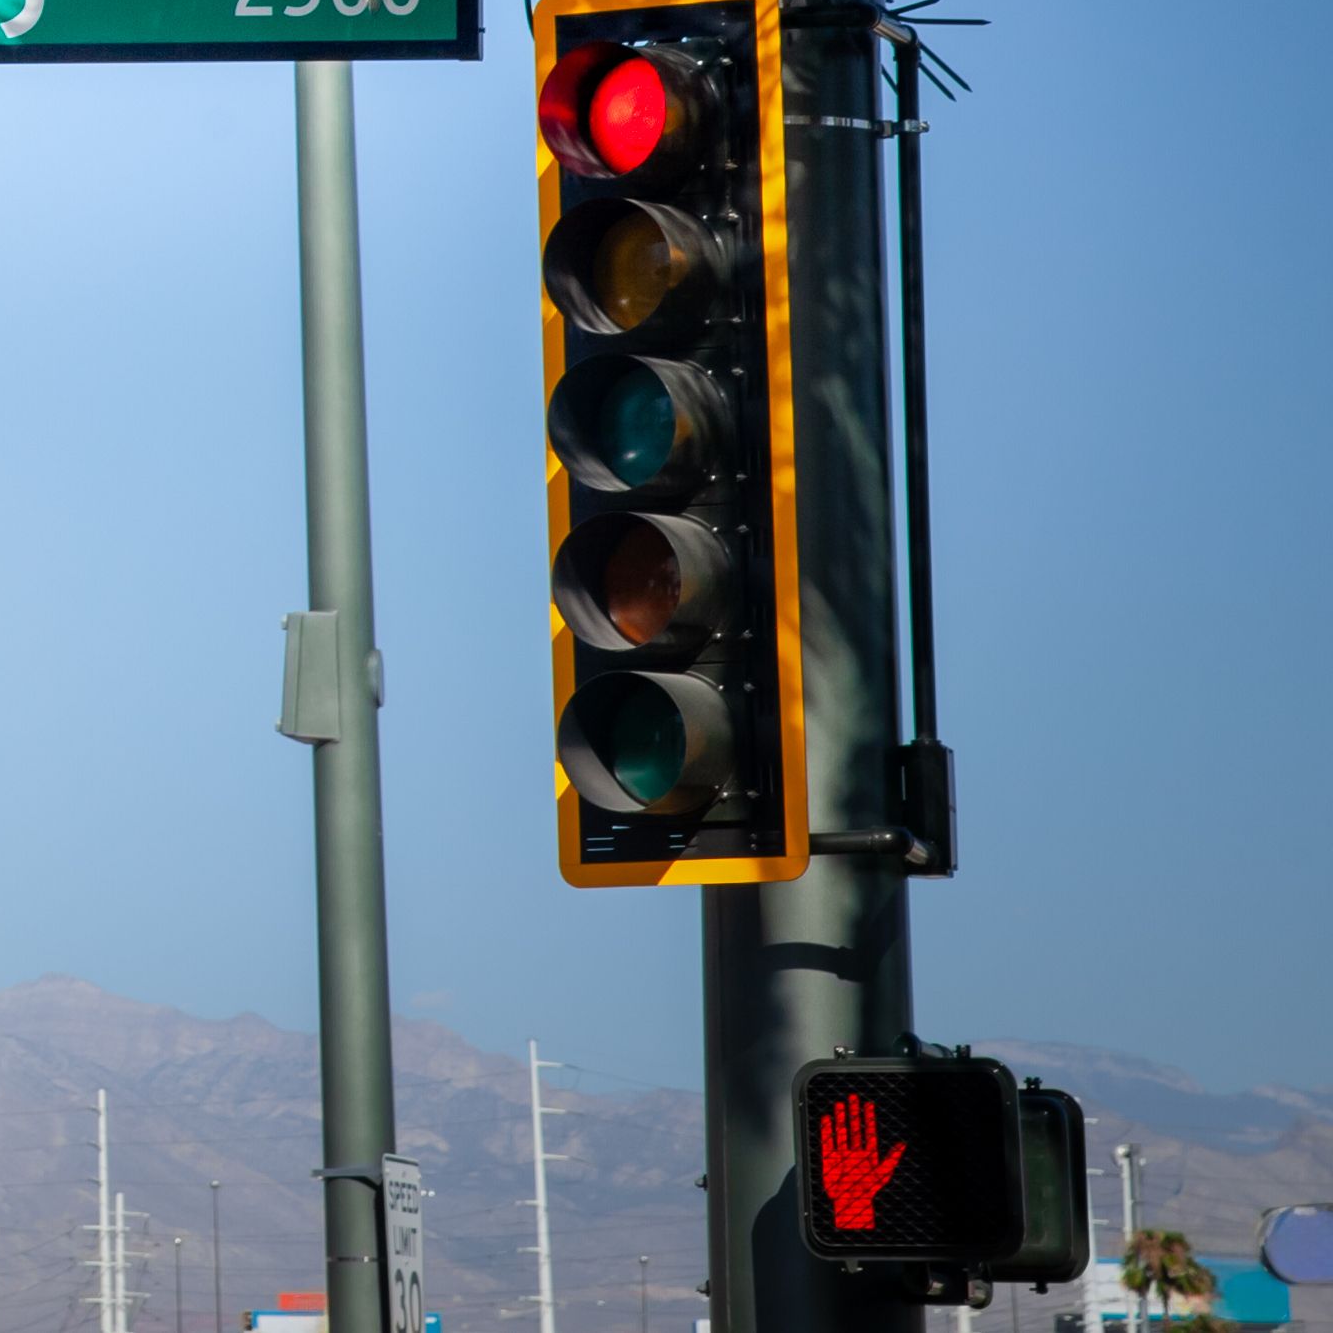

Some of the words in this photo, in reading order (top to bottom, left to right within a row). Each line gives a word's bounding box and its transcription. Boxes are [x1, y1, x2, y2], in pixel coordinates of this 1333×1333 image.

[389, 1180, 419, 1214] SPEED
[393, 1225, 418, 1257] LIMIT
[394, 1268, 422, 1333] 30
